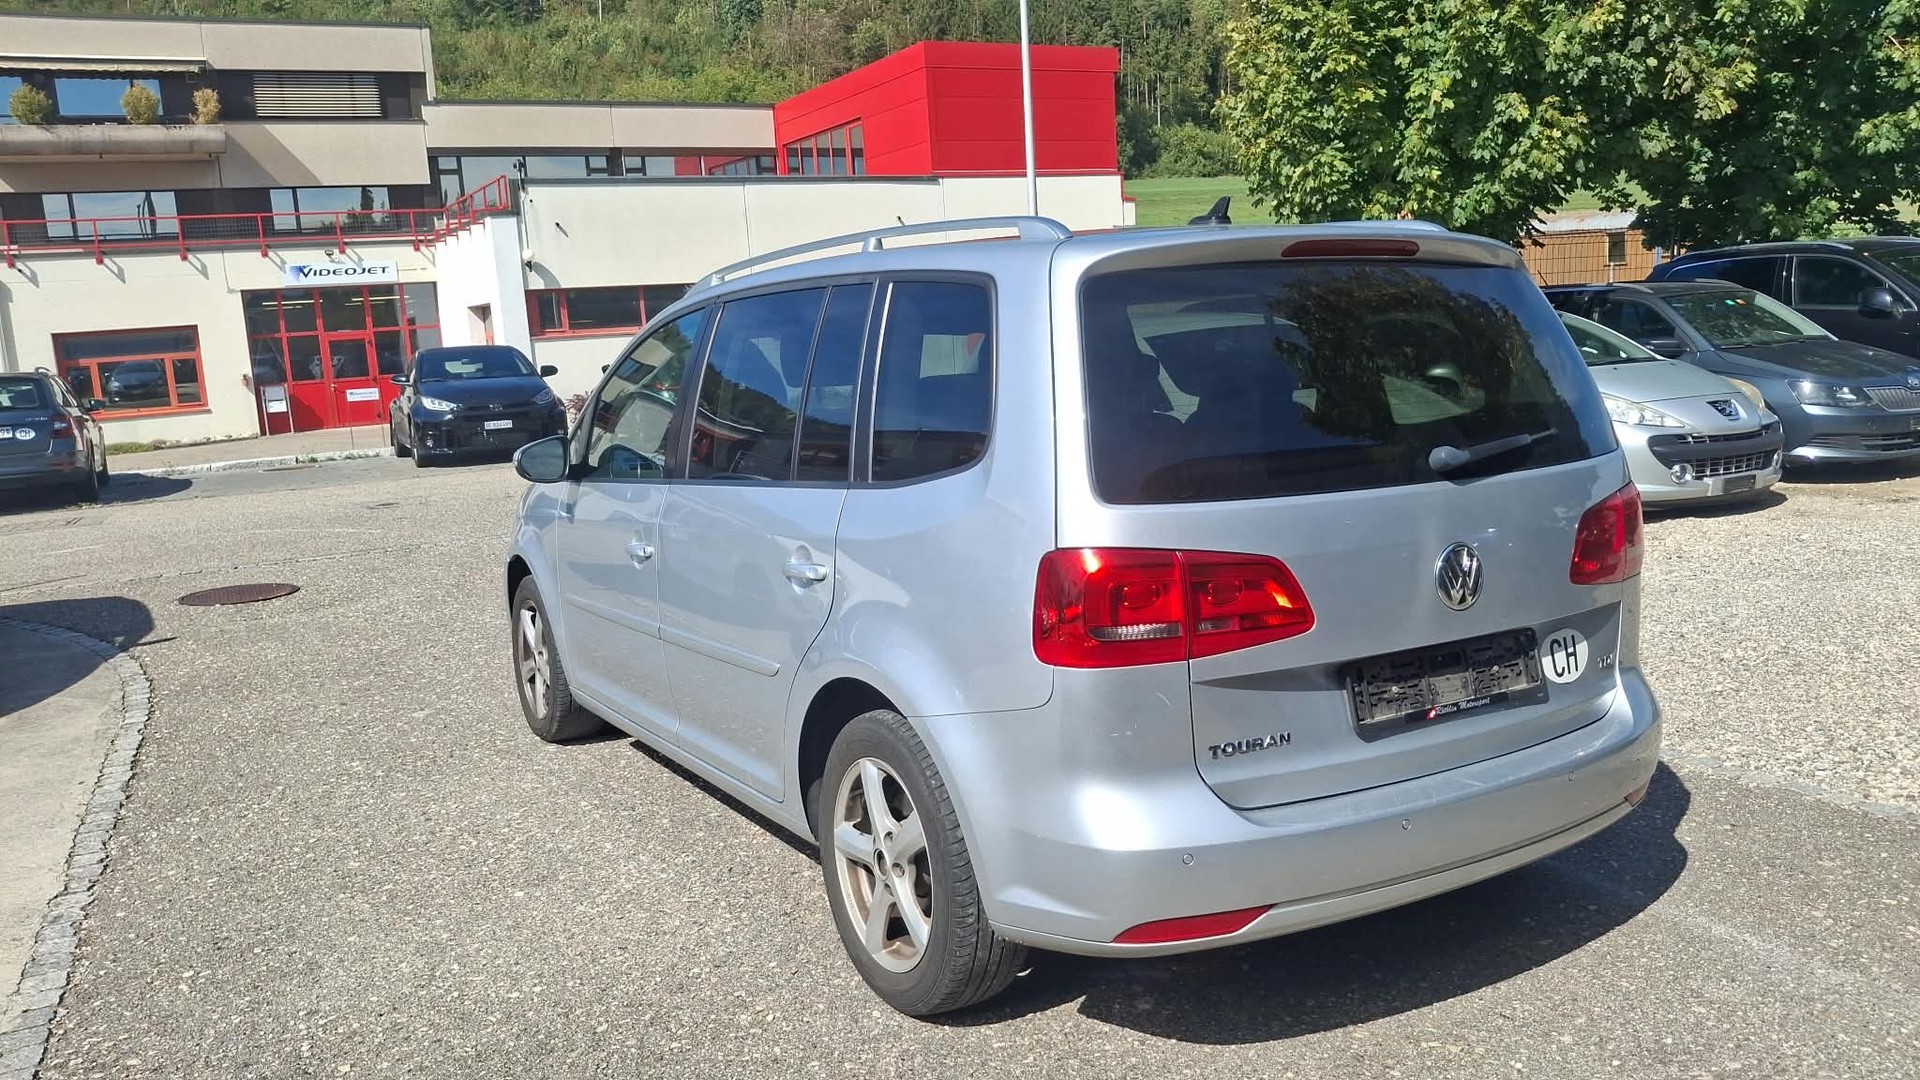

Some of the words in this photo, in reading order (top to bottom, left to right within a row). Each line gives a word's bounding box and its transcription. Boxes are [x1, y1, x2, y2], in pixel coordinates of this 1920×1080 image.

[300, 265, 390, 278] VIDEOJET
[1549, 634, 1579, 678] CH
[1208, 732, 1291, 759] TOURAN
